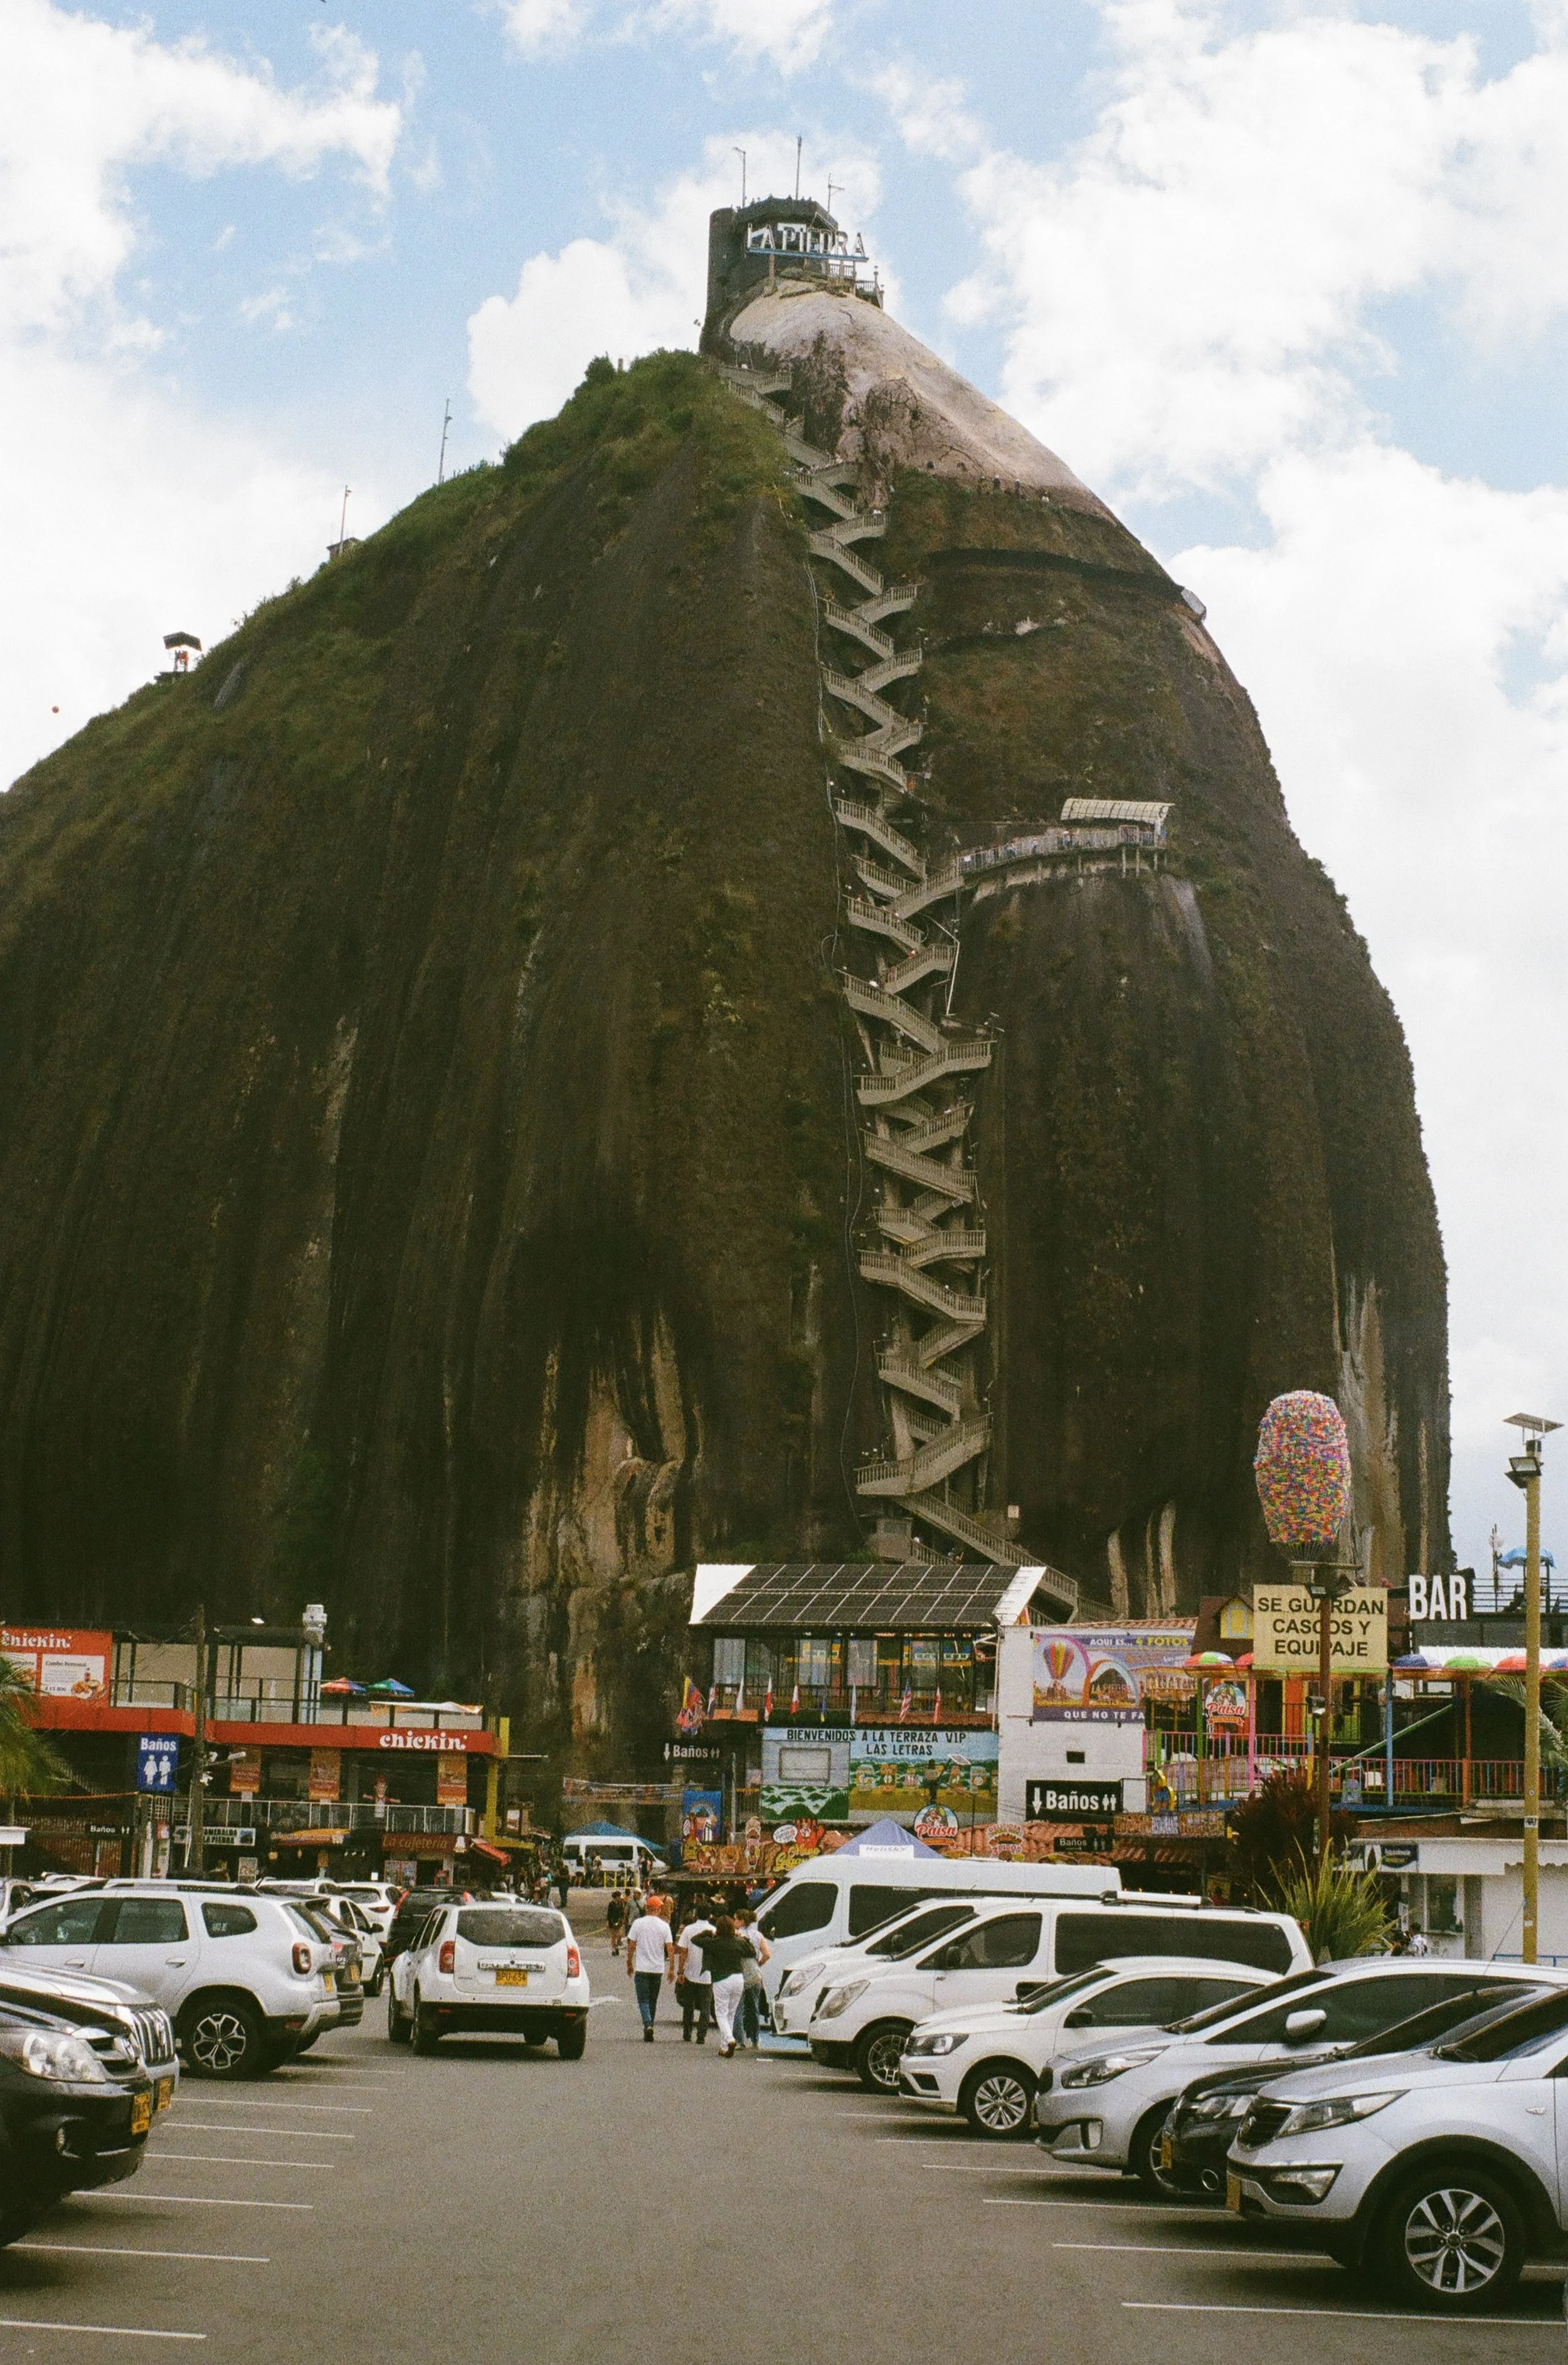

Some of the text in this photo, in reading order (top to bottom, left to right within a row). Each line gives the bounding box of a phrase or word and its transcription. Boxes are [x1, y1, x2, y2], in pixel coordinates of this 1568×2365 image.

[748, 223, 866, 257] LA PIEDRA
[1409, 1575, 1467, 1620] BAR
[1258, 1597, 1384, 1614] SE GURDAN
[1359, 1621, 1371, 1636] Y
[1147, 1637, 1189, 1646] FOTOS
[1274, 1639, 1369, 1656] EQUIAJE
[1064, 1710, 1145, 1720] QUE NO TE FA
[1207, 1702, 1245, 1716] Paisa
[787, 1730, 967, 1743] BIENVENIDOS A LA TERRAZA VIP
[140, 1737, 176, 1751] Baños
[866, 1744, 933, 1755] LAS LETRAS
[672, 1745, 708, 1758] Baños
[1046, 1790, 1099, 1811] Baños
[916, 1823, 957, 1838] Paisa
[1059, 1838, 1087, 1846] Baños
